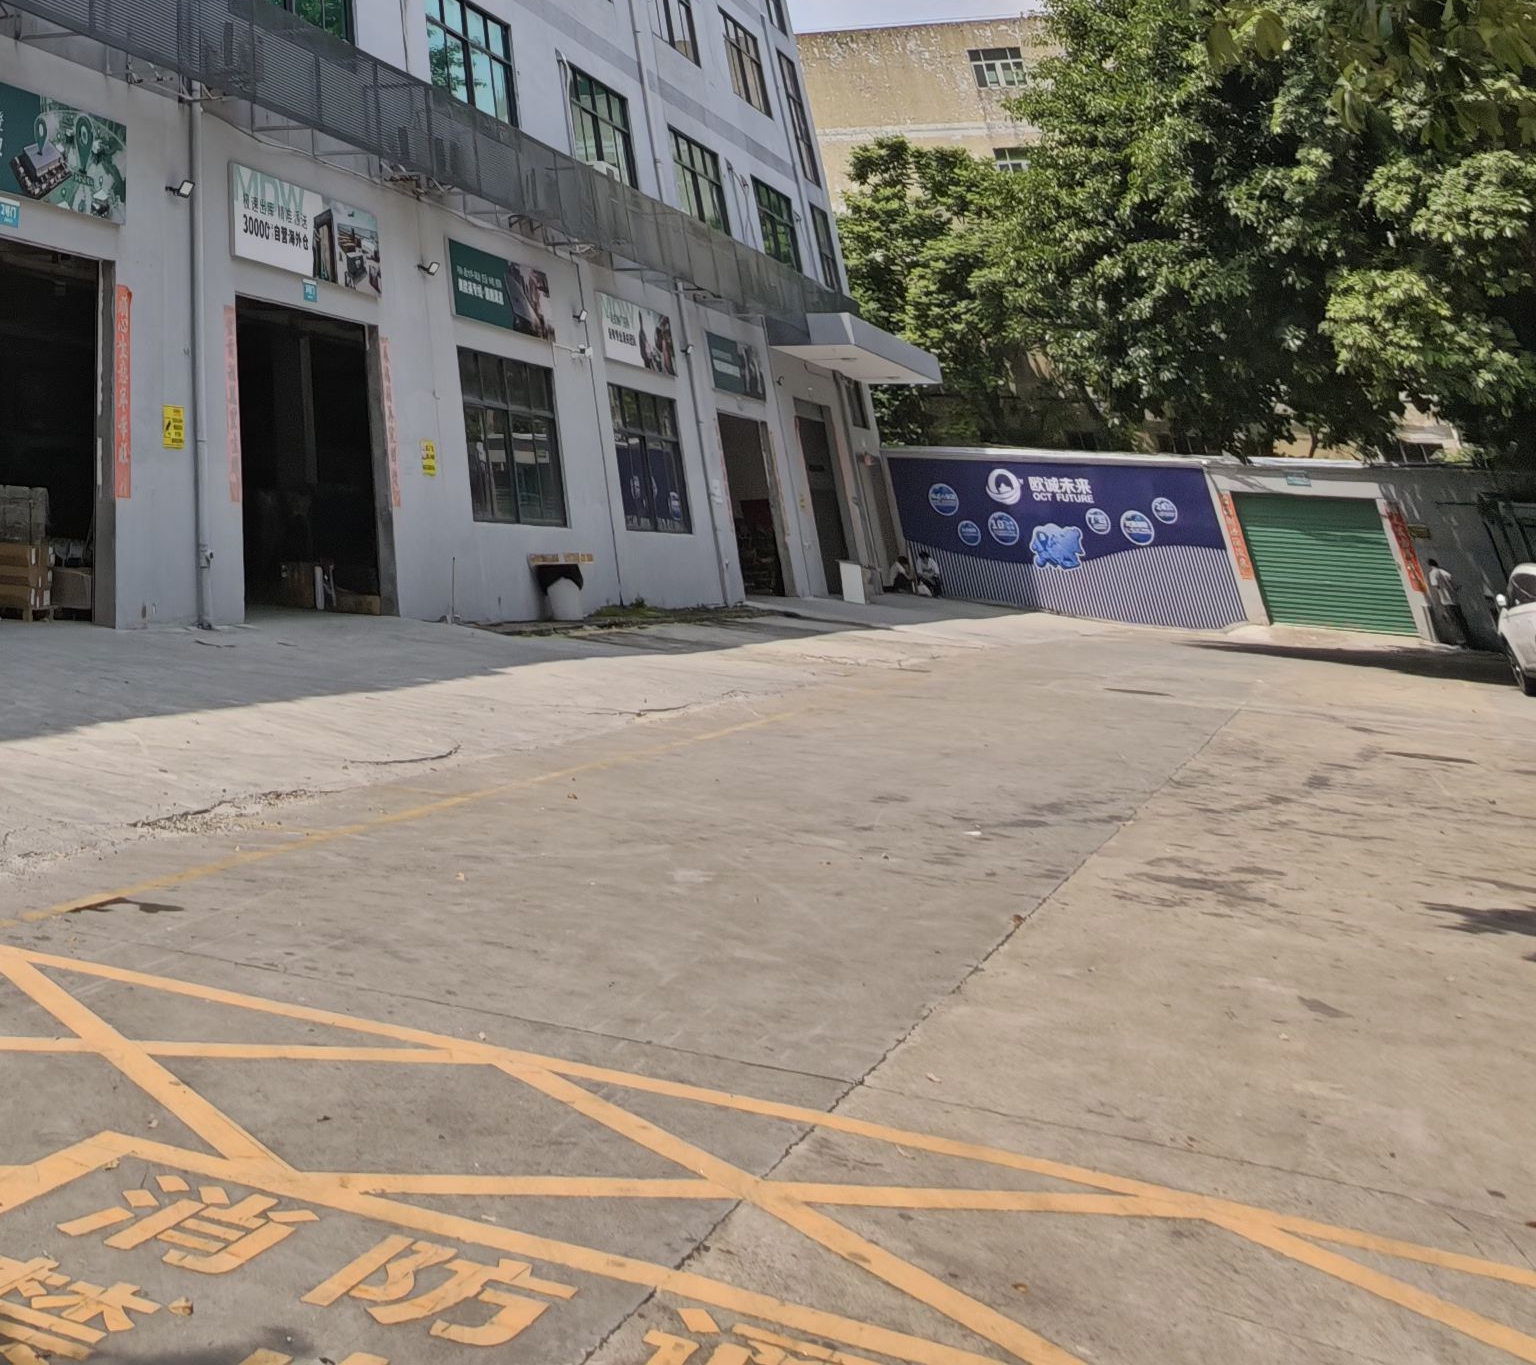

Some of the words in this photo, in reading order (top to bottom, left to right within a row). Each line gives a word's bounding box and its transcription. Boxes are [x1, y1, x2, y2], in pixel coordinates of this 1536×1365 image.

[1027, 476, 1093, 495] 欧诚未来
[1032, 492, 1052, 502] OCT
[1056, 493, 1095, 504] FUTURE
